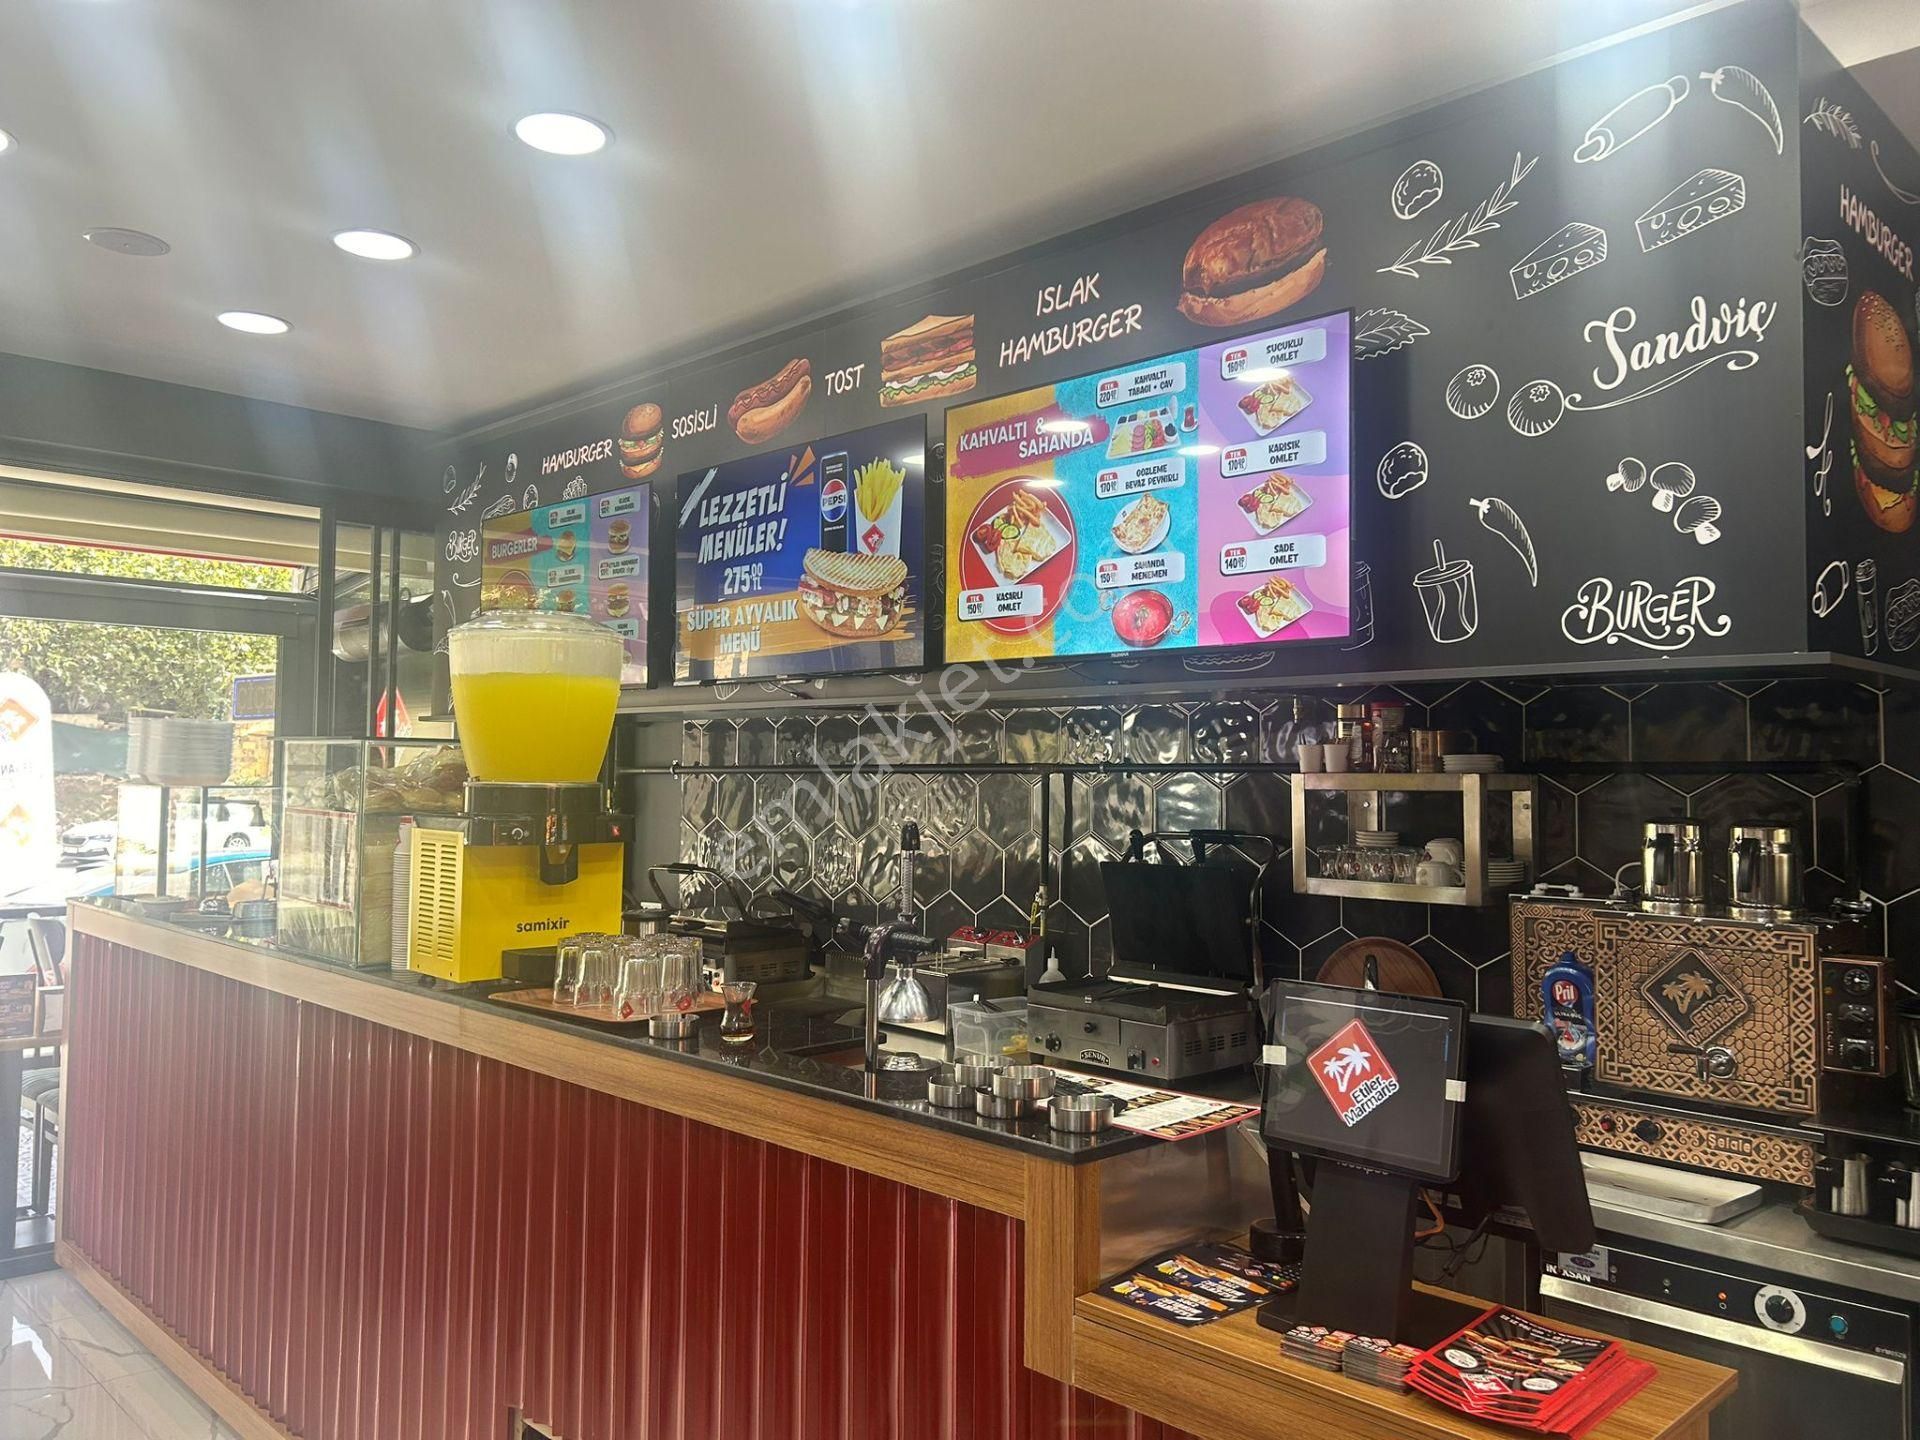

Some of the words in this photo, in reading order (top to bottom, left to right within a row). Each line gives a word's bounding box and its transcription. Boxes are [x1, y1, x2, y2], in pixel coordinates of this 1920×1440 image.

[1840, 184, 1914, 283] HAMBURGER
[1036, 273, 1100, 316] ISLAK
[999, 304, 1143, 368] HAMBURGER
[1584, 296, 1777, 391] Sandviç
[1270, 350, 1299, 364] OMLET
[824, 363, 865, 396] TOST
[671, 403, 718, 440] SOSİSLİ
[960, 421, 1027, 451] KAHVALTI
[541, 438, 613, 475] HAMBURGER
[1019, 427, 1094, 458] SAHANDA
[1270, 452, 1299, 465] OMLET
[698, 472, 789, 528] LEZZETLİ
[822, 494, 846, 507] PEPSI
[491, 536, 538, 560] BURGERLER
[698, 518, 788, 564] MENÜLER!
[1274, 543, 1295, 553] SADE
[1269, 554, 1299, 565] OMLET
[687, 605, 731, 631] SÜPER
[734, 598, 799, 626] AYVALIK
[997, 602, 1021, 612] OMLET
[1562, 576, 1731, 651] BURGER
[720, 625, 760, 654] MENÜ
[516, 917, 570, 933] samixir
[1555, 984, 1574, 1000] Pril
[1344, 1079, 1399, 1127] Marmaris
[1351, 1075, 1385, 1104] Etiler
